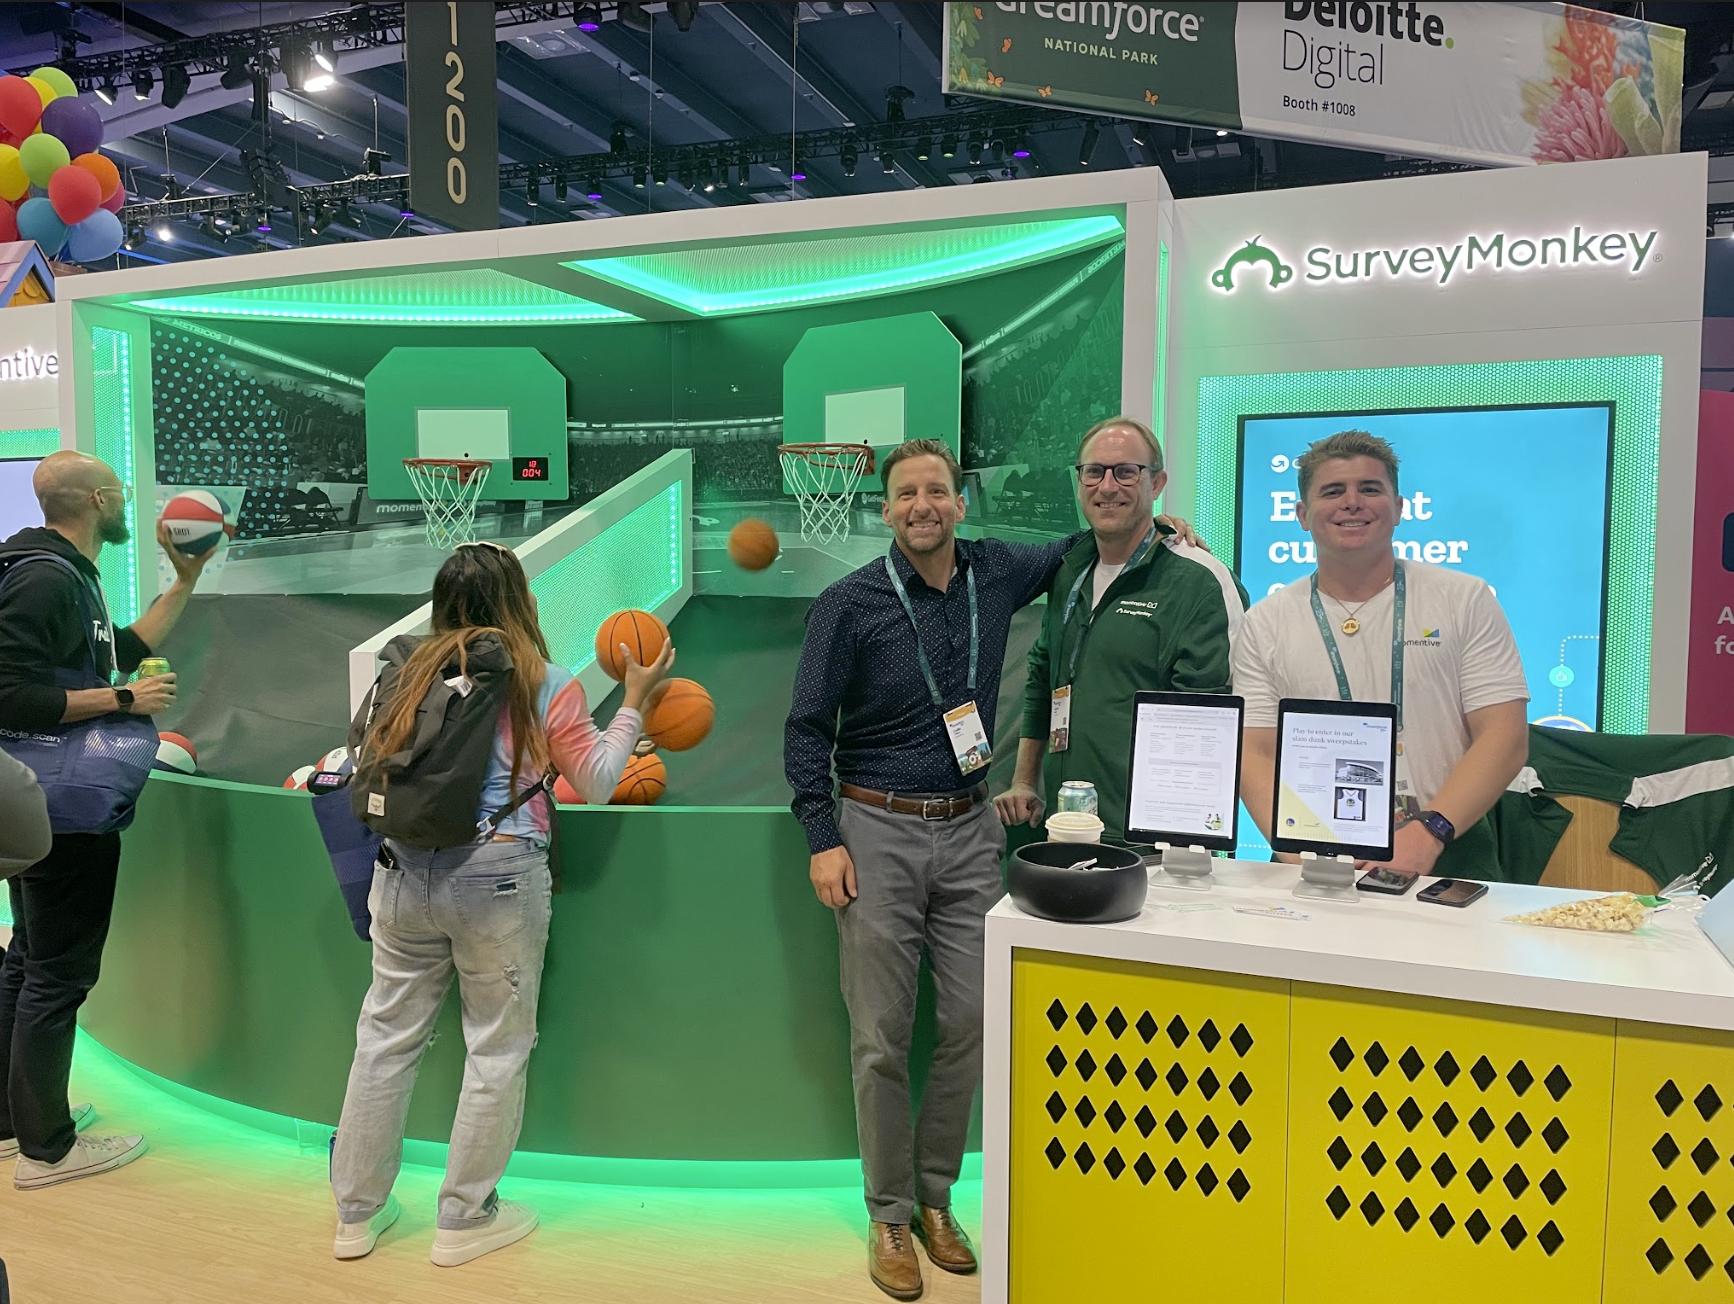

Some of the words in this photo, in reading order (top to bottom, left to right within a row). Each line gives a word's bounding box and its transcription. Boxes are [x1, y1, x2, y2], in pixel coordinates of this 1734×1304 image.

[1045, 37, 1117, 59] NATIONAL
[1122, 50, 1158, 65] PARK
[1283, 29, 1384, 89] Digital
[445, 2, 467, 204] 1200
[1283, 95, 1318, 111] Booth
[1322, 101, 1356, 116] #1008
[1306, 226, 1658, 284] SurveyMonkey
